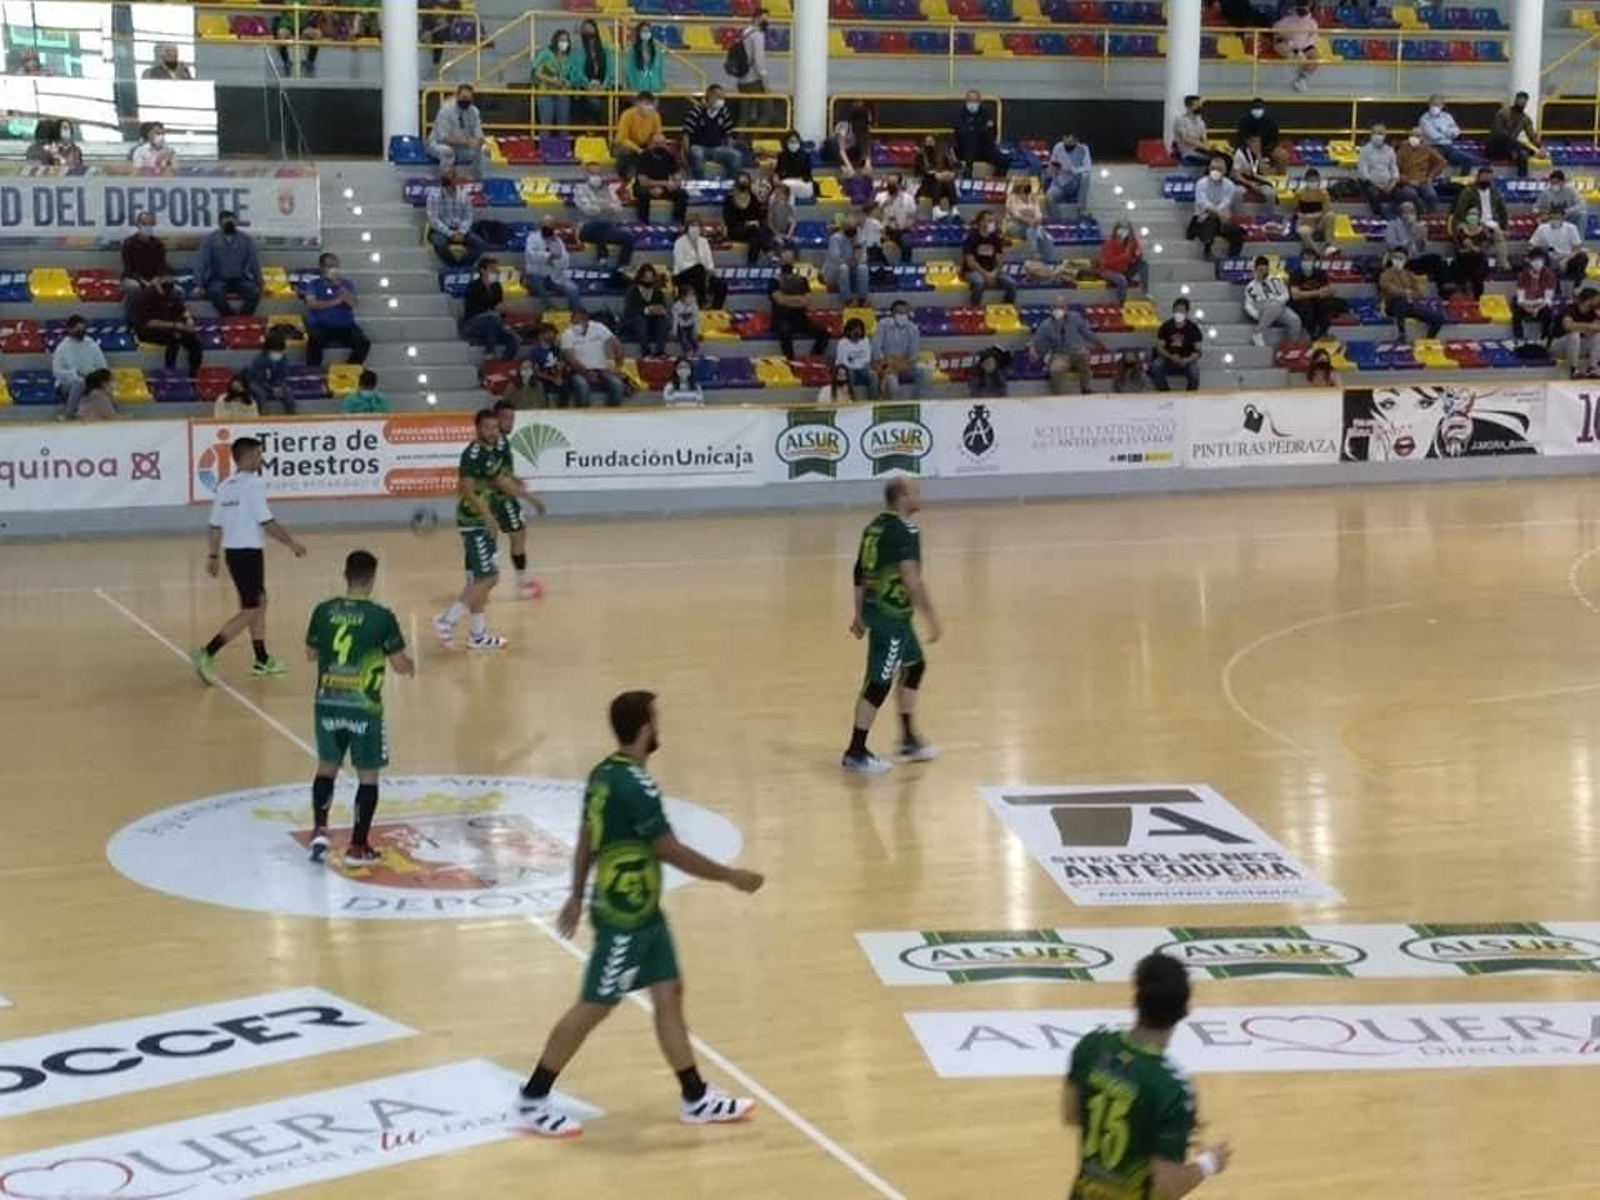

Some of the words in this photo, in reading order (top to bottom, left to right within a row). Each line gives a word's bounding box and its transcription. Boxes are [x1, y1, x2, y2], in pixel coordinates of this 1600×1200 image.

[33, 186, 96, 226] DEL
[104, 186, 251, 227] DEPORTE
[1576, 393, 1600, 443] 1
[256, 431, 337, 453] Tierra
[346, 429, 379, 450] de
[786, 430, 840, 449] ALSUR
[871, 427, 924, 448] ALSUR
[1193, 442, 1266, 458] PINTURAS
[1268, 439, 1338, 454] PEDRAZA
[0, 447, 118, 489] quinoa
[258, 456, 380, 477] Maestros
[333, 624, 353, 666] 4
[1064, 863, 1302, 878] ANTEQUERA
[931, 945, 1081, 963] ALSUR
[1185, 941, 1340, 959] ALSUR
[1429, 937, 1578, 955] ALSUR
[957, 1014, 1600, 1054] ANEQUER
